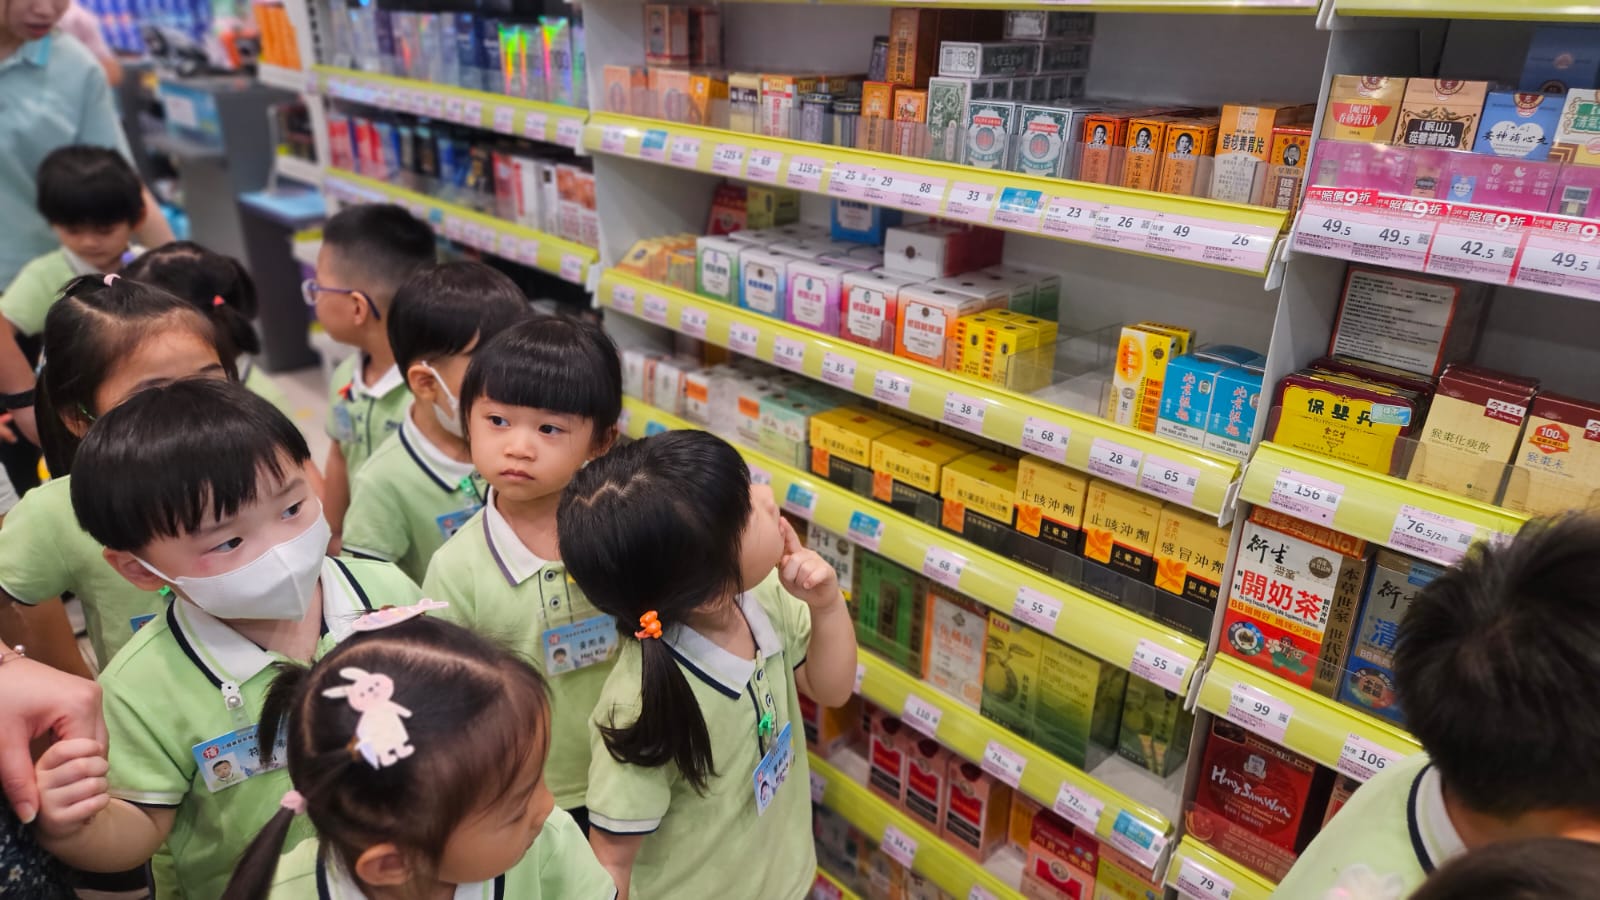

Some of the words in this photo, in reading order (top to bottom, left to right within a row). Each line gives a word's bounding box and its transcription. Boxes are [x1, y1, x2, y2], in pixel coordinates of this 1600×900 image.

[845, 170, 856, 180] 25
[881, 176, 893, 187] 29
[919, 182, 932, 193] 88
[967, 190, 980, 201] 33
[1067, 207, 1082, 218] 23
[1118, 216, 1134, 228] 26
[1322, 218, 1351, 236] 49.5
[1173, 225, 1190, 237] 49
[1379, 228, 1410, 246] 49.5
[1232, 233, 1249, 246] 26
[1460, 240, 1495, 259] 42.5
[1551, 252, 1589, 271] 49.5
[835, 363, 845, 374] 35
[888, 380, 899, 391] 35
[960, 403, 972, 415] 38
[1041, 430, 1054, 442] 68
[1108, 451, 1123, 465] 28
[1164, 469, 1179, 482] 65
[1294, 484, 1320, 500] 156
[939, 560, 950, 571] 68
[1240, 569, 1323, 621] 開奶茶
[1031, 602, 1044, 613] 55
[1152, 656, 1167, 670] 55
[1253, 702, 1270, 715] 99
[1359, 750, 1386, 768] 106
[1199, 876, 1215, 890] 79
